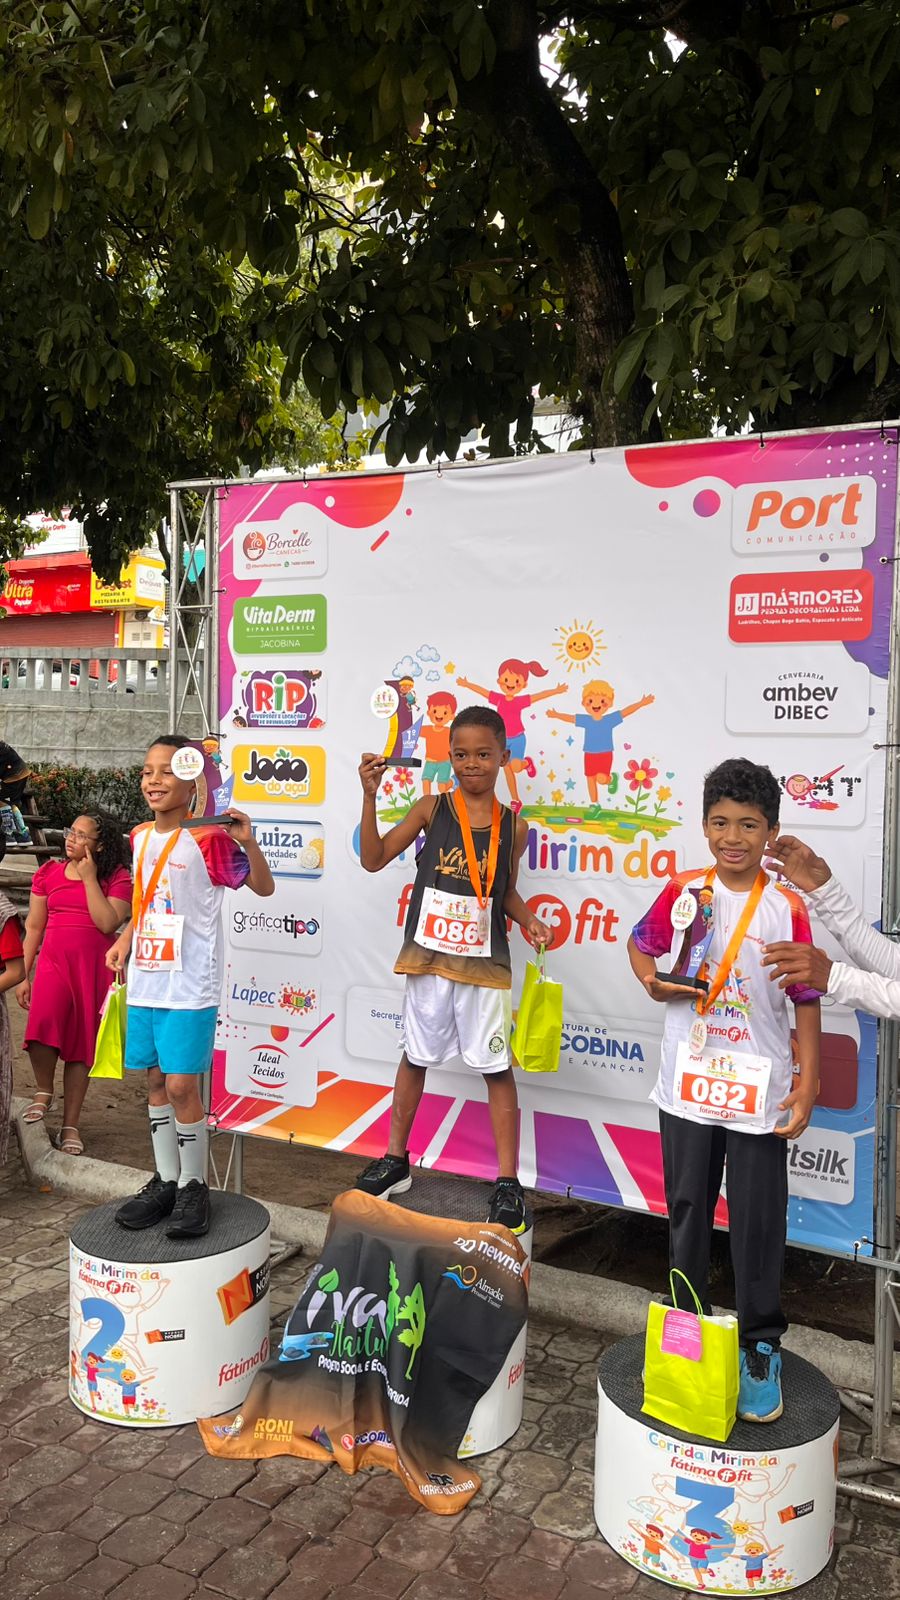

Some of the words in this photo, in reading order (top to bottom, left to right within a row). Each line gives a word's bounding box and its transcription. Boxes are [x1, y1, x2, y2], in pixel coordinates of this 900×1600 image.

[746, 483, 863, 532] Port
[266, 532, 312, 551] Borcelle
[746, 531, 857, 545] COMUNICAÇÃO
[4, 583, 33, 598] Ultra
[761, 588, 863, 607] MÁRMORES
[260, 639, 301, 648] JACOBINA
[778, 671, 824, 681] CERVEJARIA
[762, 683, 838, 702] ambev
[774, 705, 829, 720] DIBEC
[267, 780, 281, 793] do
[261, 849, 297, 859] riedades
[623, 838, 677, 879] da
[574, 898, 619, 944] fit
[433, 918, 478, 945] 086
[231, 983, 276, 1006] Lapec
[283, 993, 312, 1009] KIDS
[370, 1009, 403, 1020] Secretar
[560, 1023, 590, 1033] ITURA
[594, 1027, 607, 1035] DE
[706, 1024, 727, 1036] tima
[560, 1032, 645, 1062] COBINA
[257, 1051, 281, 1065] Ideal
[583, 1059, 644, 1074] AVANÇAR
[252, 1064, 285, 1079] Tecidos
[691, 1077, 747, 1111] 082
[787, 1143, 849, 1176] tsilk
[79, 1269, 105, 1288] fátima
[121, 1282, 136, 1293] fit
[101, 1263, 138, 1279] Mirim
[140, 1269, 160, 1281] da
[475, 1278, 504, 1302] Almacks
[304, 1266, 387, 1339] iva
[80, 1297, 126, 1379] 2
[218, 1355, 261, 1387] fátima
[254, 1418, 294, 1435] RONI
[253, 1432, 264, 1440] DE
[265, 1433, 292, 1442] ITAITU
[648, 1431, 704, 1461] Corrida
[711, 1450, 755, 1466] Mirim
[758, 1455, 777, 1467] da
[670, 1456, 716, 1478] fátima
[737, 1469, 752, 1482] fit
[669, 1475, 737, 1563] 3
